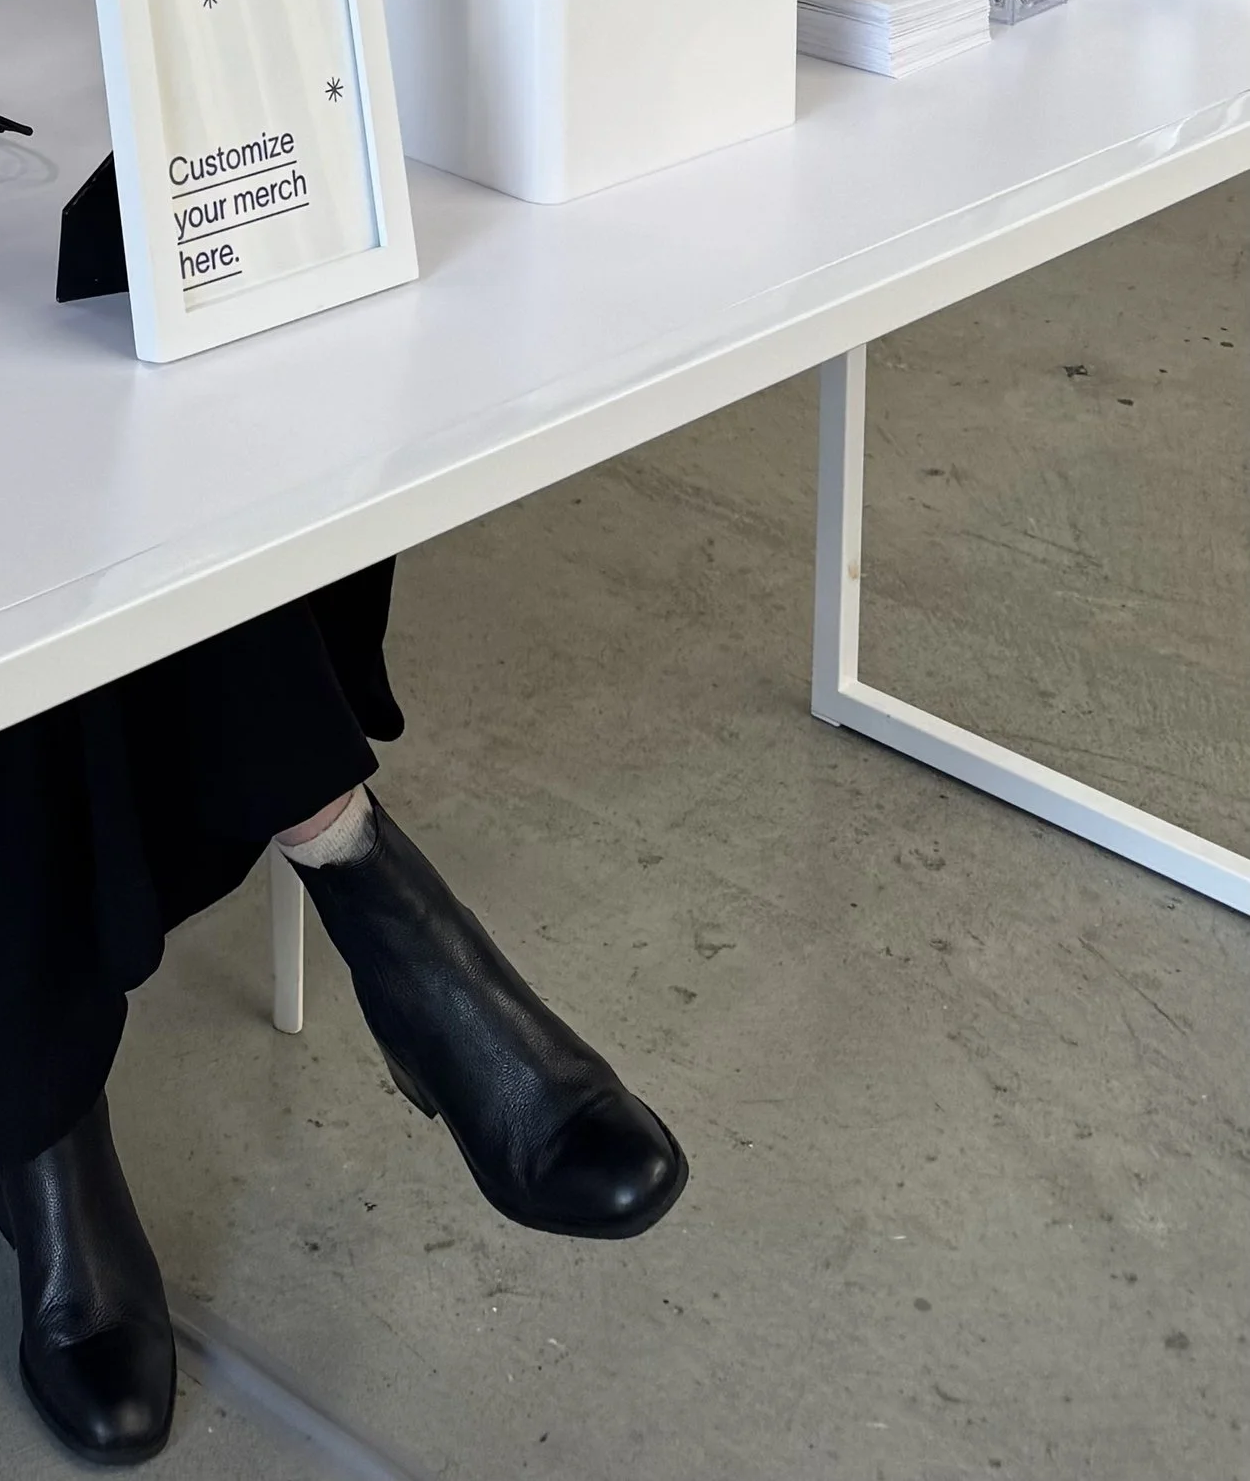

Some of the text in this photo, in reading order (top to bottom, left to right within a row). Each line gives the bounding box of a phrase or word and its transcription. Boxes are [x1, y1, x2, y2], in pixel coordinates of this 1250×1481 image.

[169, 132, 295, 186] Customize
[174, 170, 307, 240] your merch
[179, 243, 240, 279] here.
